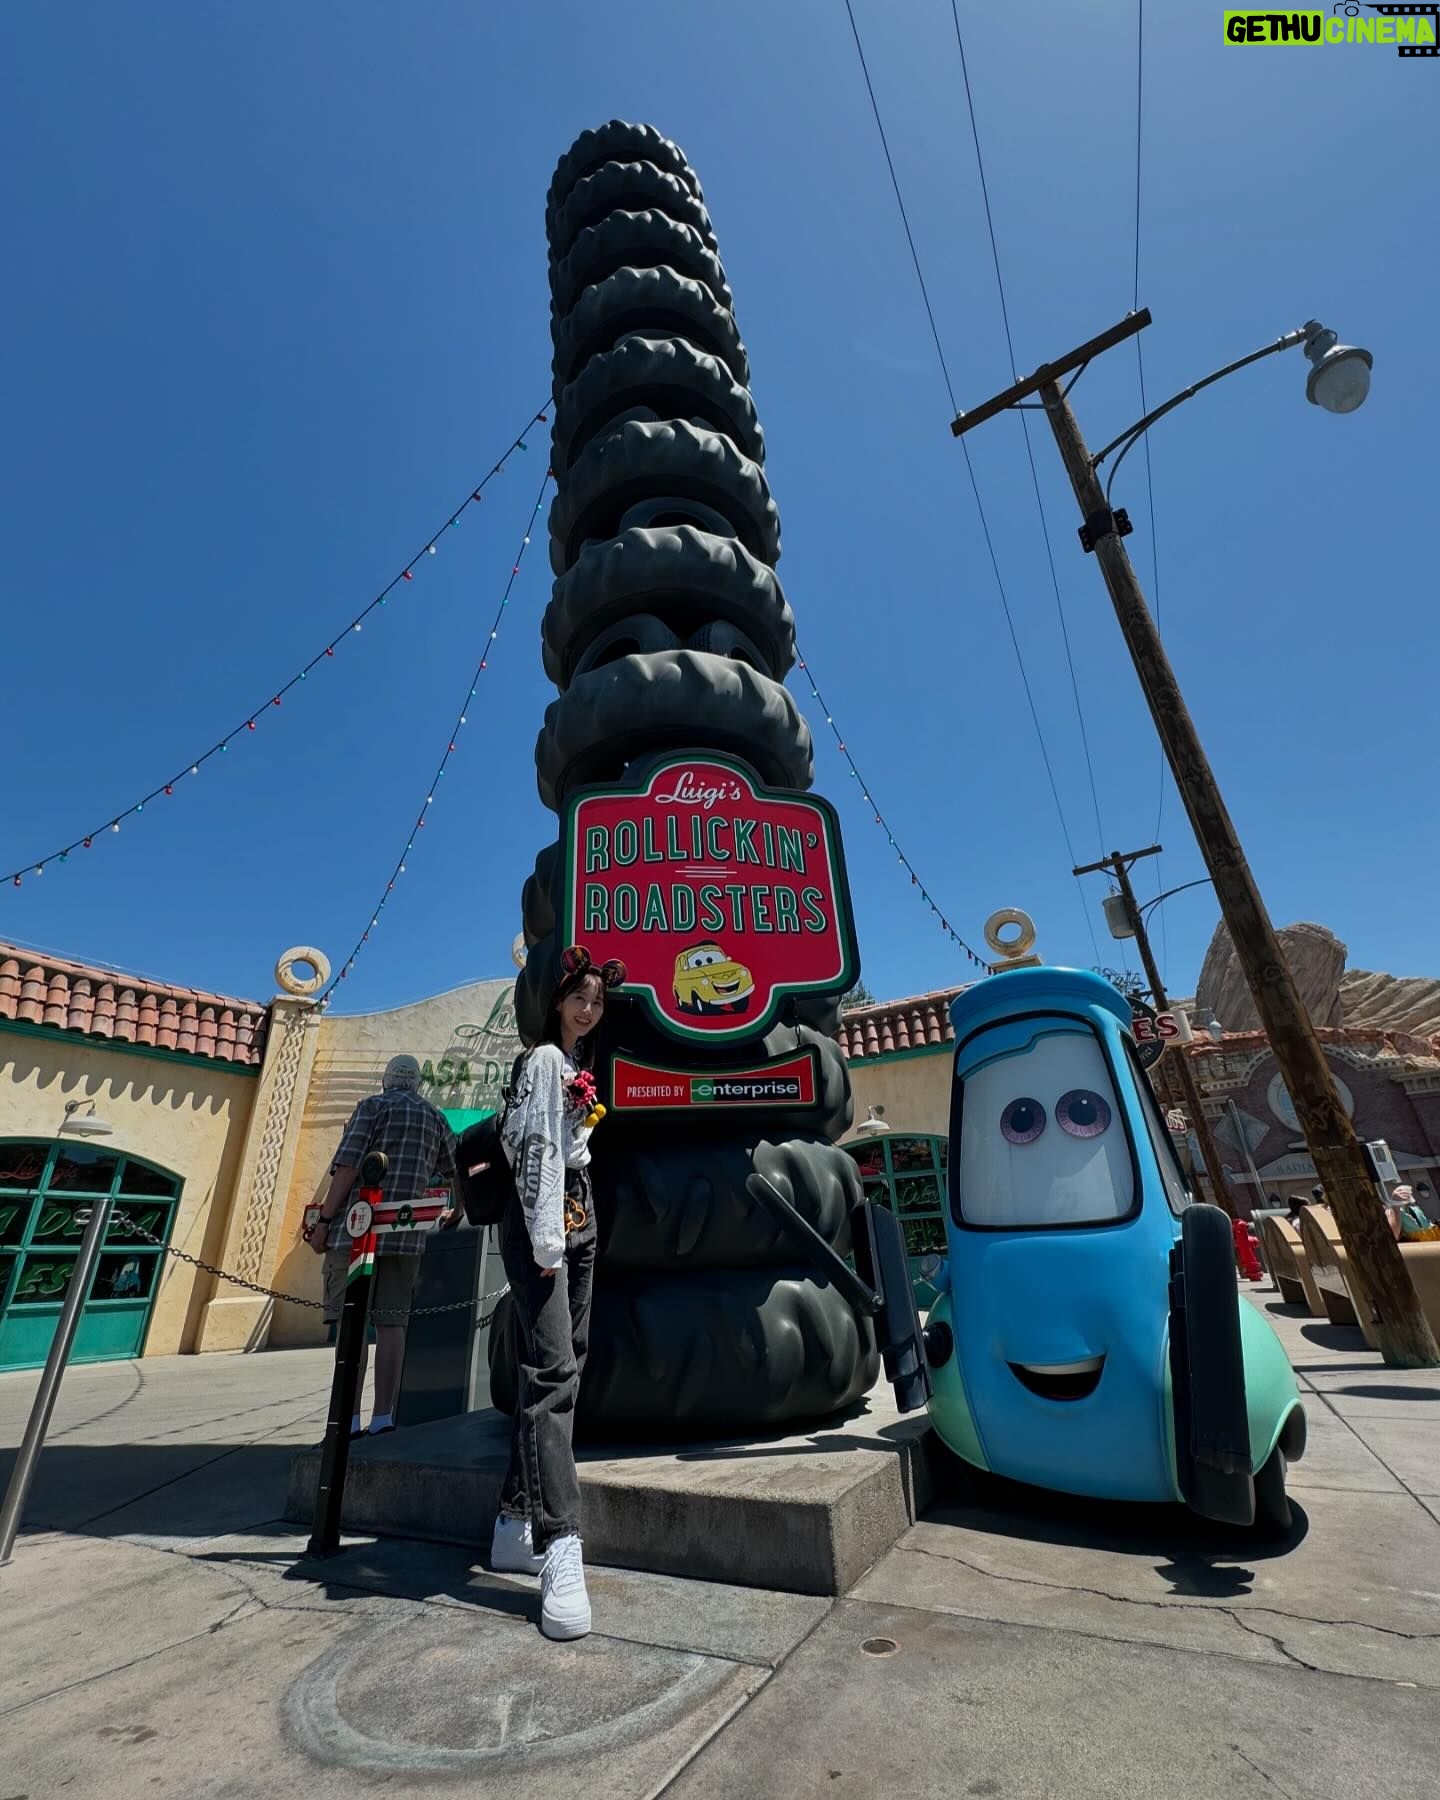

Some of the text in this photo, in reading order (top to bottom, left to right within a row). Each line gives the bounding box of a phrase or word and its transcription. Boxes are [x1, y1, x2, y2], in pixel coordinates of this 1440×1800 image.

[654, 771, 742, 809] Luigi's
[584, 814, 818, 875] ROLLICKIN'
[583, 882, 828, 933] ROADSTERS
[420, 1059, 472, 1087] ASA
[626, 1080, 799, 1098] PRESENTED BY enterprise
